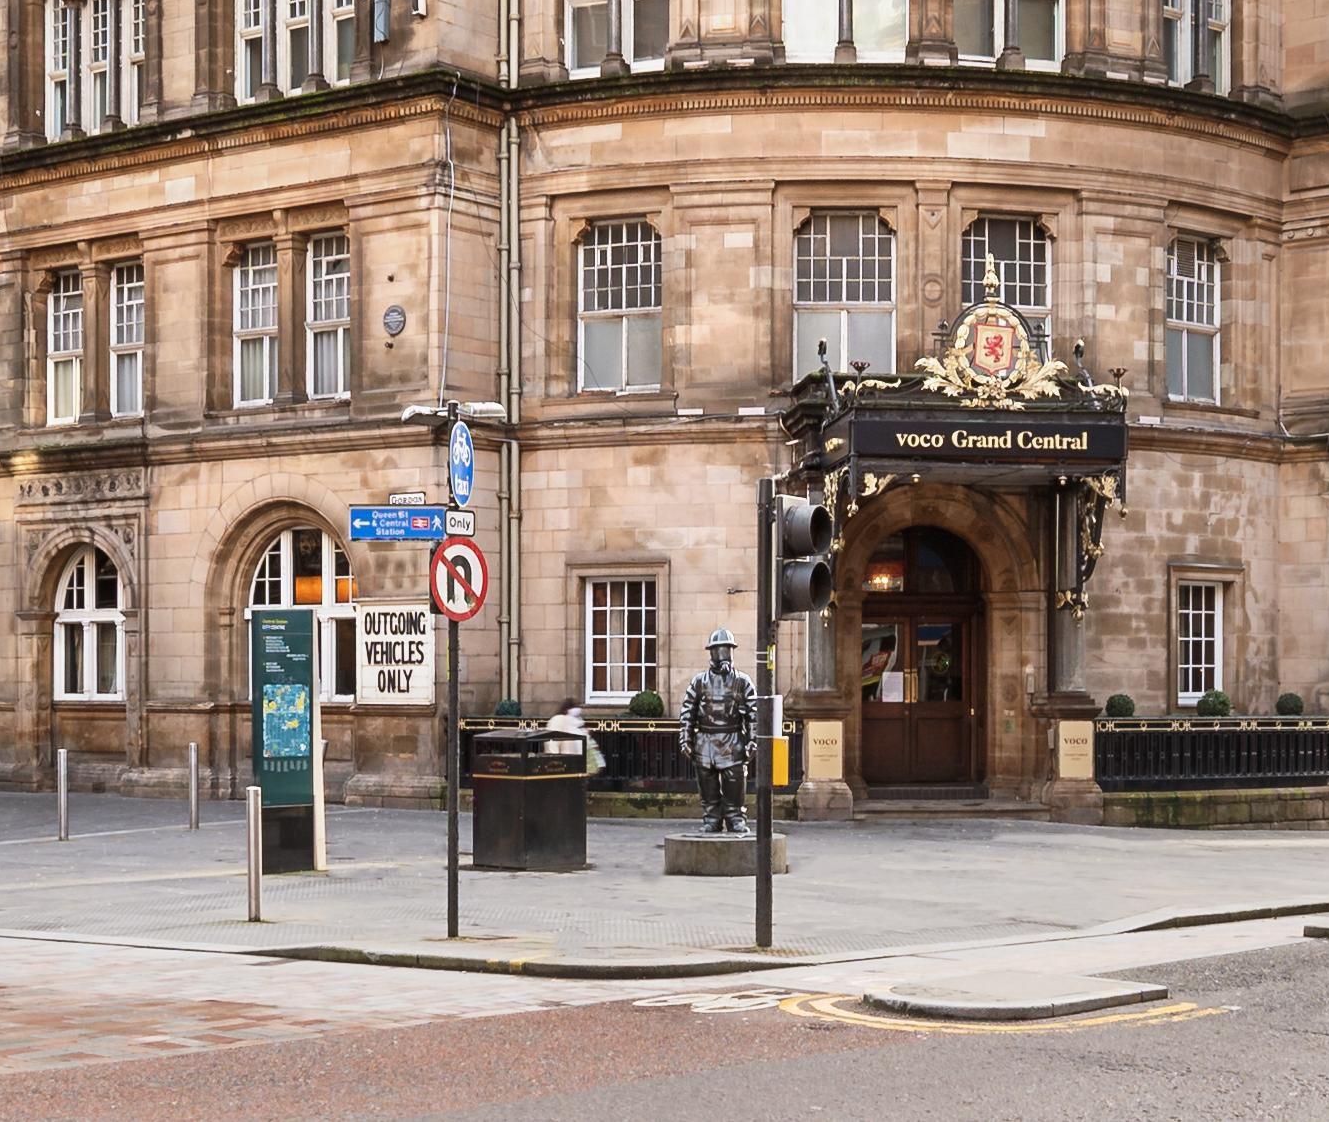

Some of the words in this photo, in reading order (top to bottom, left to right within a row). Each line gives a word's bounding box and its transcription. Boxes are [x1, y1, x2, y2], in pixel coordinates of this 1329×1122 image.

[896, 432, 944, 448] voco
[951, 430, 1012, 448] Grand
[1017, 431, 1088, 450] Central
[455, 474, 469, 496] taxi
[371, 511, 397, 520] Queen
[372, 519, 378, 527] &
[380, 518, 409, 527] Central
[450, 517, 471, 530] Only
[375, 528, 405, 536] Station
[364, 611, 427, 635] OUTGOING
[365, 641, 425, 665] VEHICLES
[377, 669, 413, 693] ONLY
